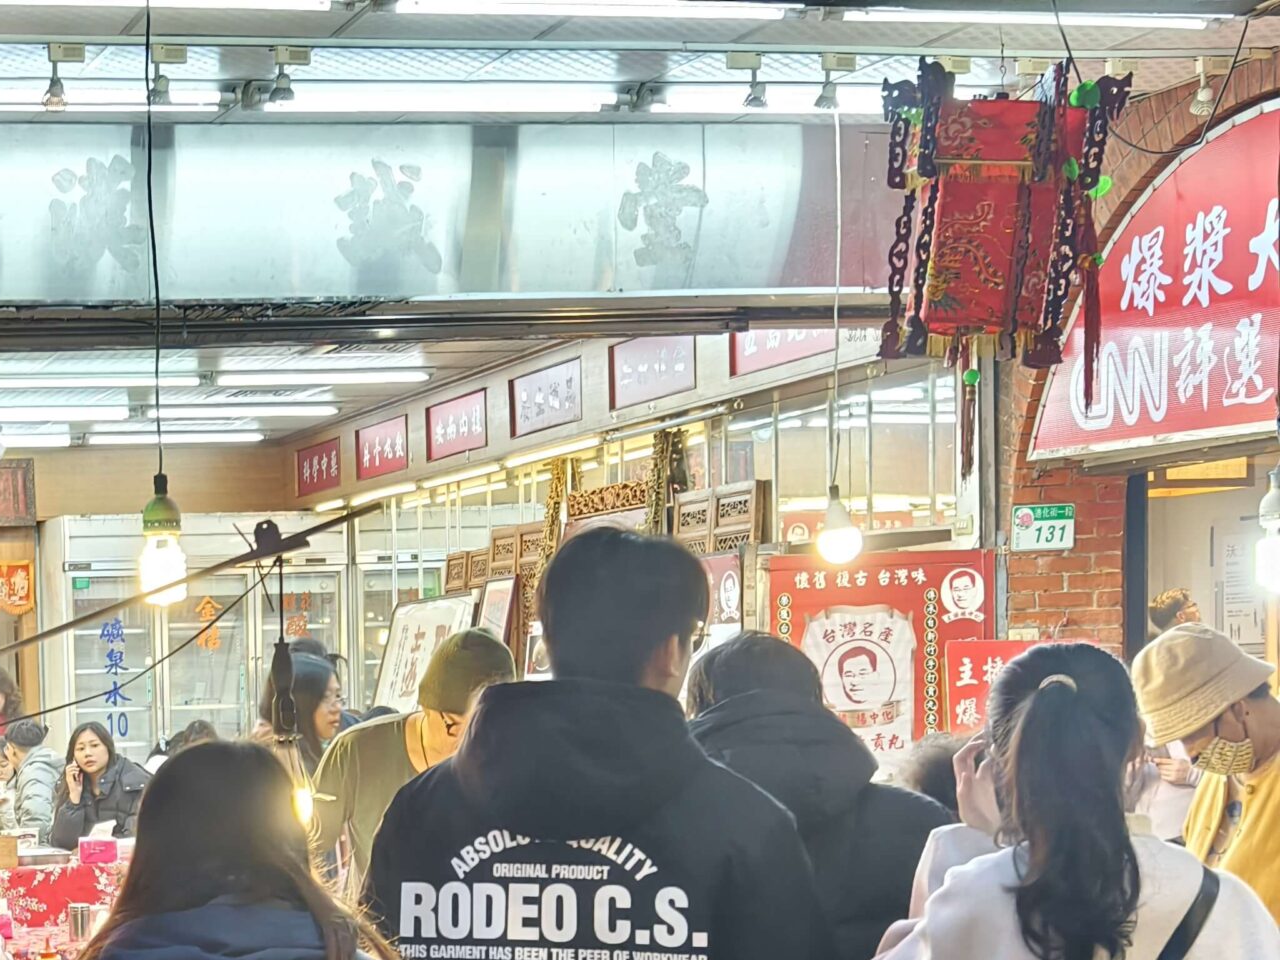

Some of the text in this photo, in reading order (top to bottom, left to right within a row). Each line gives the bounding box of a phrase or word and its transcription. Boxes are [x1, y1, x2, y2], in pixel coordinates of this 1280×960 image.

[1035, 524, 1067, 544] 131
[877, 567, 928, 587] 台灣味
[822, 621, 895, 645] 台灣名產
[99, 617, 132, 707] 礦泉水
[106, 711, 129, 737] 10
[861, 732, 905, 752] 貢丸
[450, 829, 540, 879] ABSOL
[492, 862, 611, 880] ORIGINAL PRODUCT
[400, 881, 709, 948] RODEO C.S.
[429, 945, 487, 960] GARMENT
[488, 946, 512, 960] HAS
